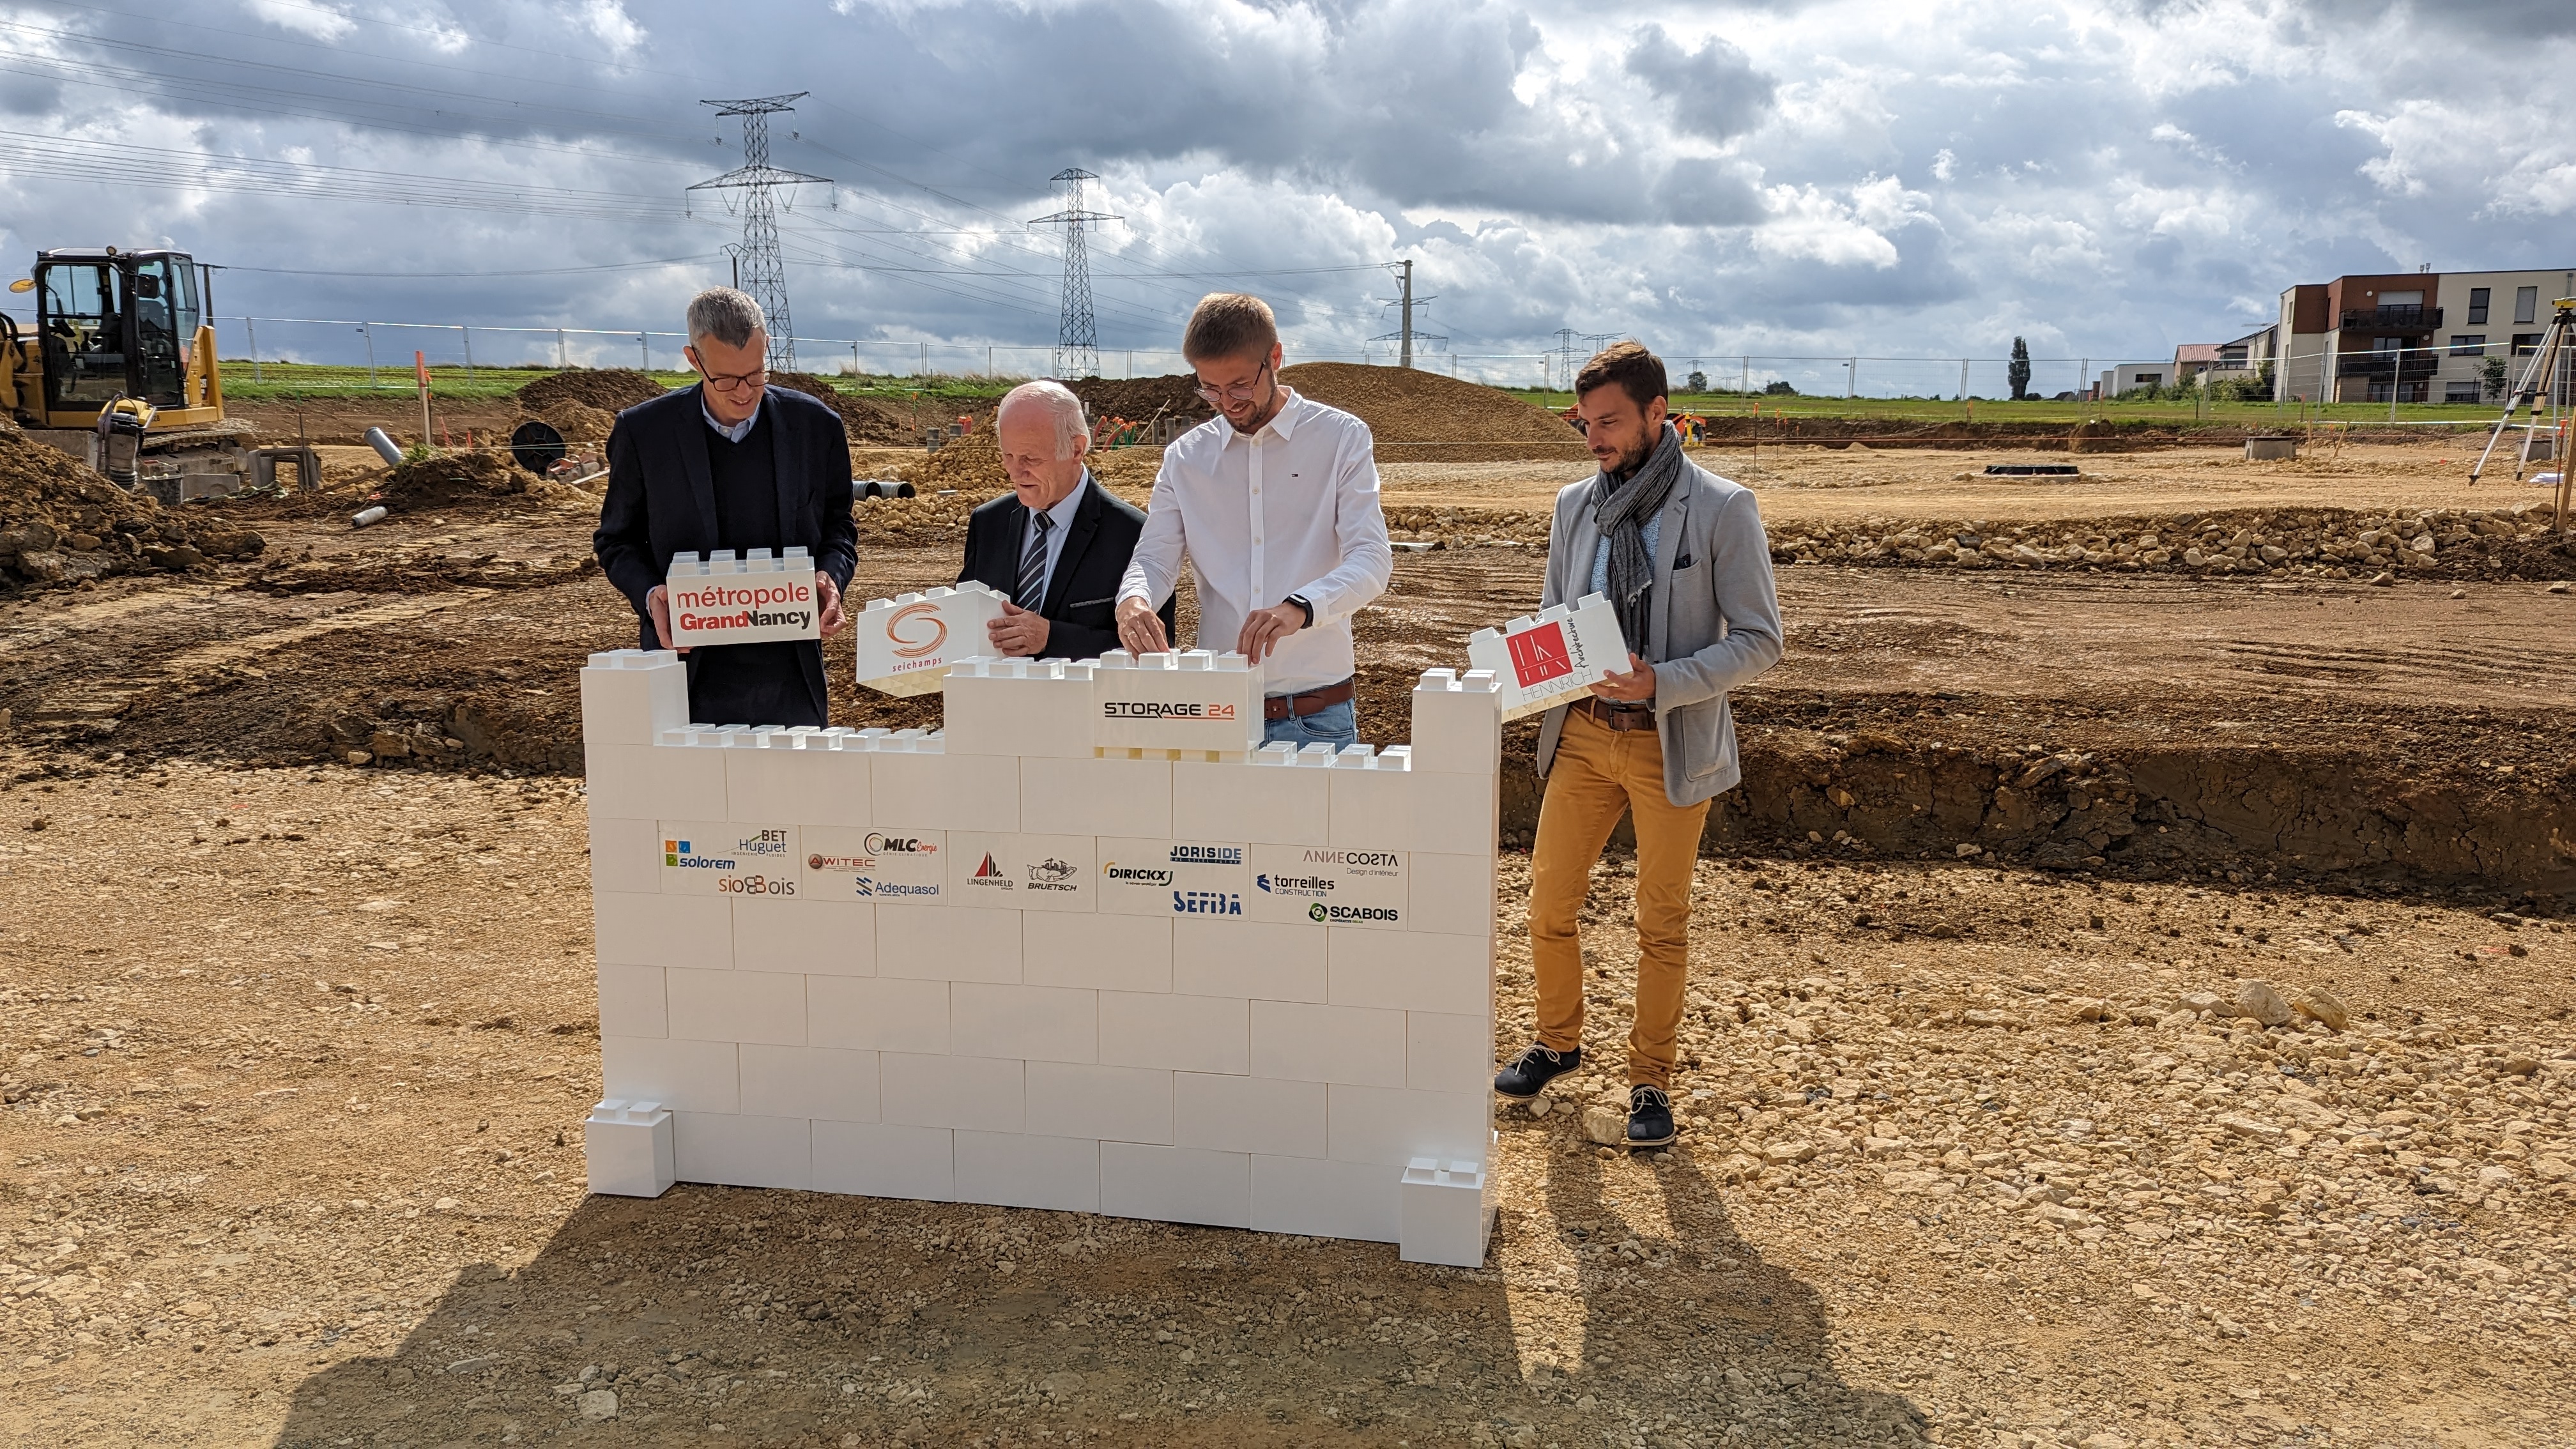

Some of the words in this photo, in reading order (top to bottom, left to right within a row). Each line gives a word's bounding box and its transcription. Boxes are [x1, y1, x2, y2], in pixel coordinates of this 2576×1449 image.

[677, 581, 809, 609] métropole
[893, 657, 942, 672] seichamps
[1522, 669, 1593, 702] HENNRICH
[1105, 702, 1201, 717] STORAGE
[1208, 704, 1235, 717] 24
[762, 829, 787, 842] BET
[739, 839, 787, 855] Huguet
[884, 838, 918, 852] MLC
[1170, 846, 1242, 859] JORISIDE
[1110, 868, 1166, 880] DIRICKX
[1346, 868, 1368, 876] Design
[875, 882, 939, 896] Adequasol
[967, 878, 1013, 887] LINGENHELD
[1027, 882, 1077, 891] BRUETSCH
[1274, 874, 1335, 890] torreilles
[1275, 888, 1327, 897] CONSTRUCTION
[1174, 891, 1241, 915] SEFIBA
[1330, 906, 1399, 921] SCABOIS
